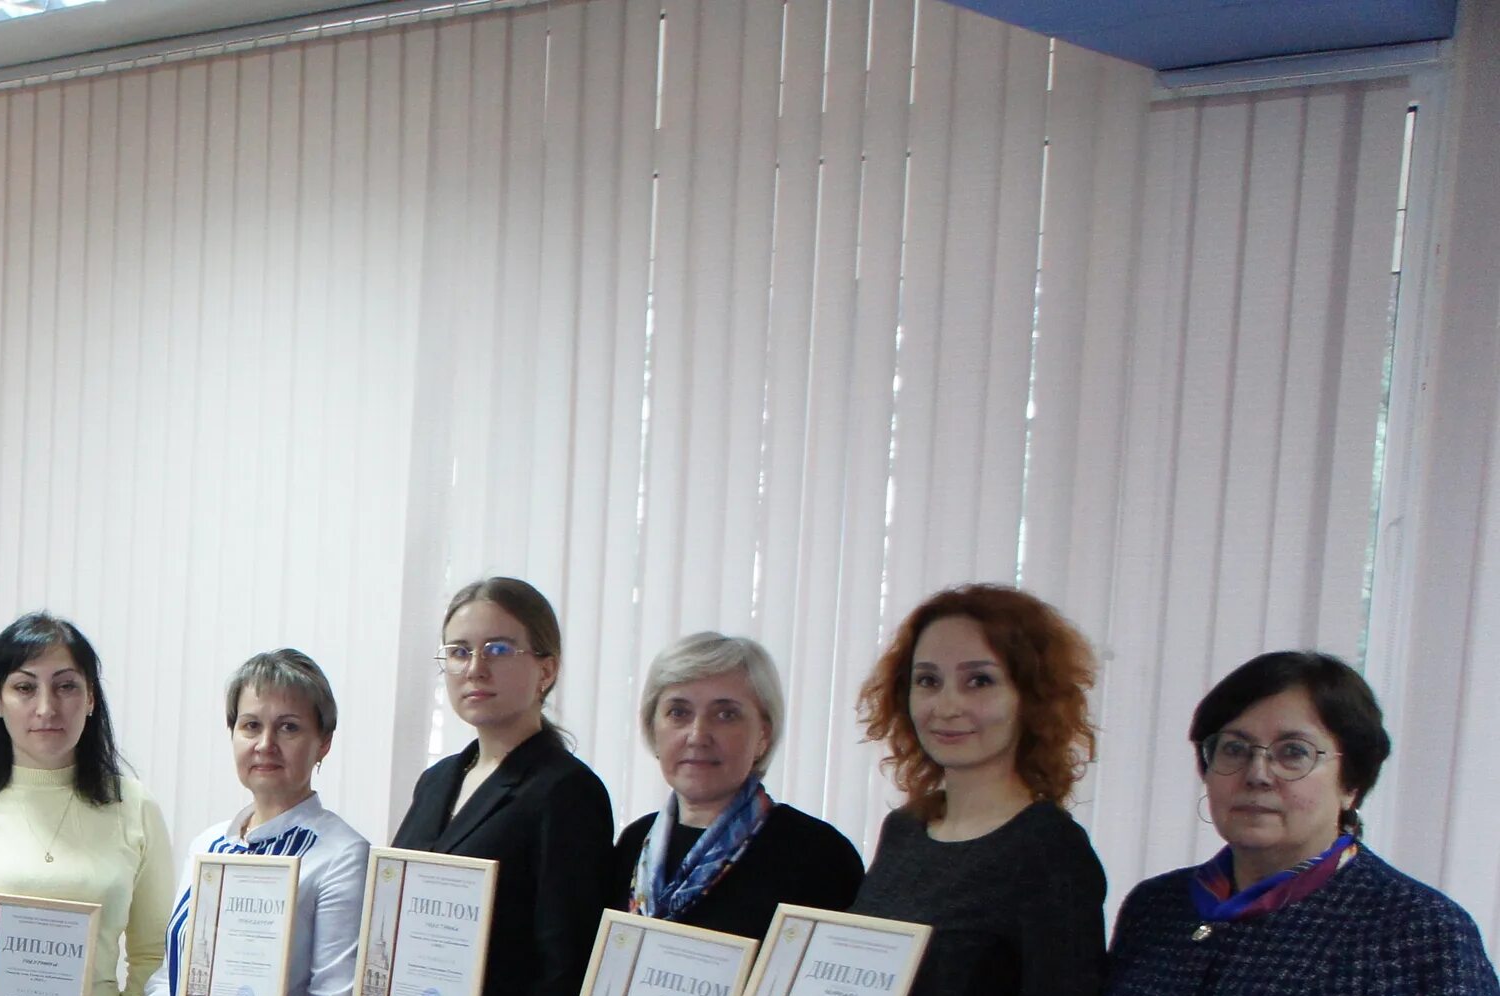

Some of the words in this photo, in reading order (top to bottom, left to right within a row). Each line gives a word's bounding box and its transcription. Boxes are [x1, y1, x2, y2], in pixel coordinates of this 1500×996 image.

[225, 897, 285, 915] ДИПЛОМ
[408, 897, 479, 922] ДИПЛОМ
[2, 936, 84, 959] ДИПЛОМ
[805, 960, 896, 991] ДИПЛОМ
